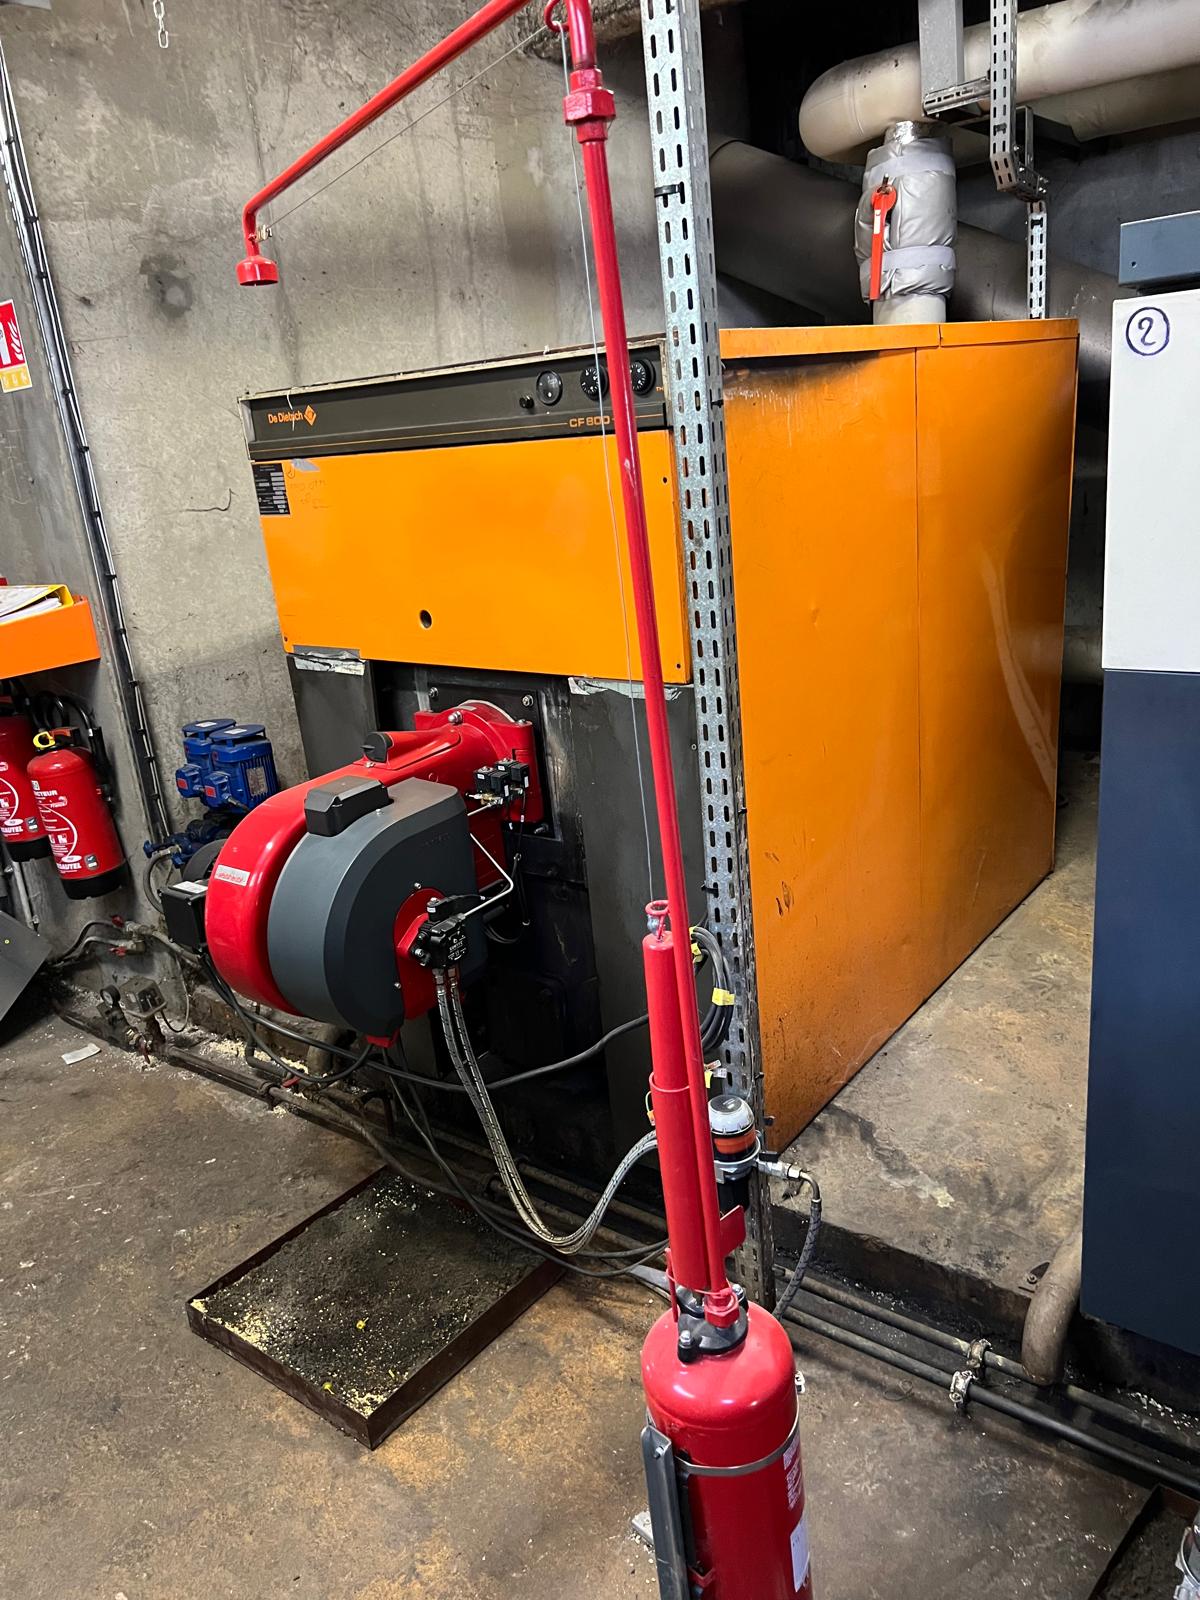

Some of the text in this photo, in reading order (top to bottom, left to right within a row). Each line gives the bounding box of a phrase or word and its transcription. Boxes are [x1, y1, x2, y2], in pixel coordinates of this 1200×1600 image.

[1137, 316, 1157, 347] 2
[268, 413, 278, 423] De
[569, 415, 611, 428] CF 800
